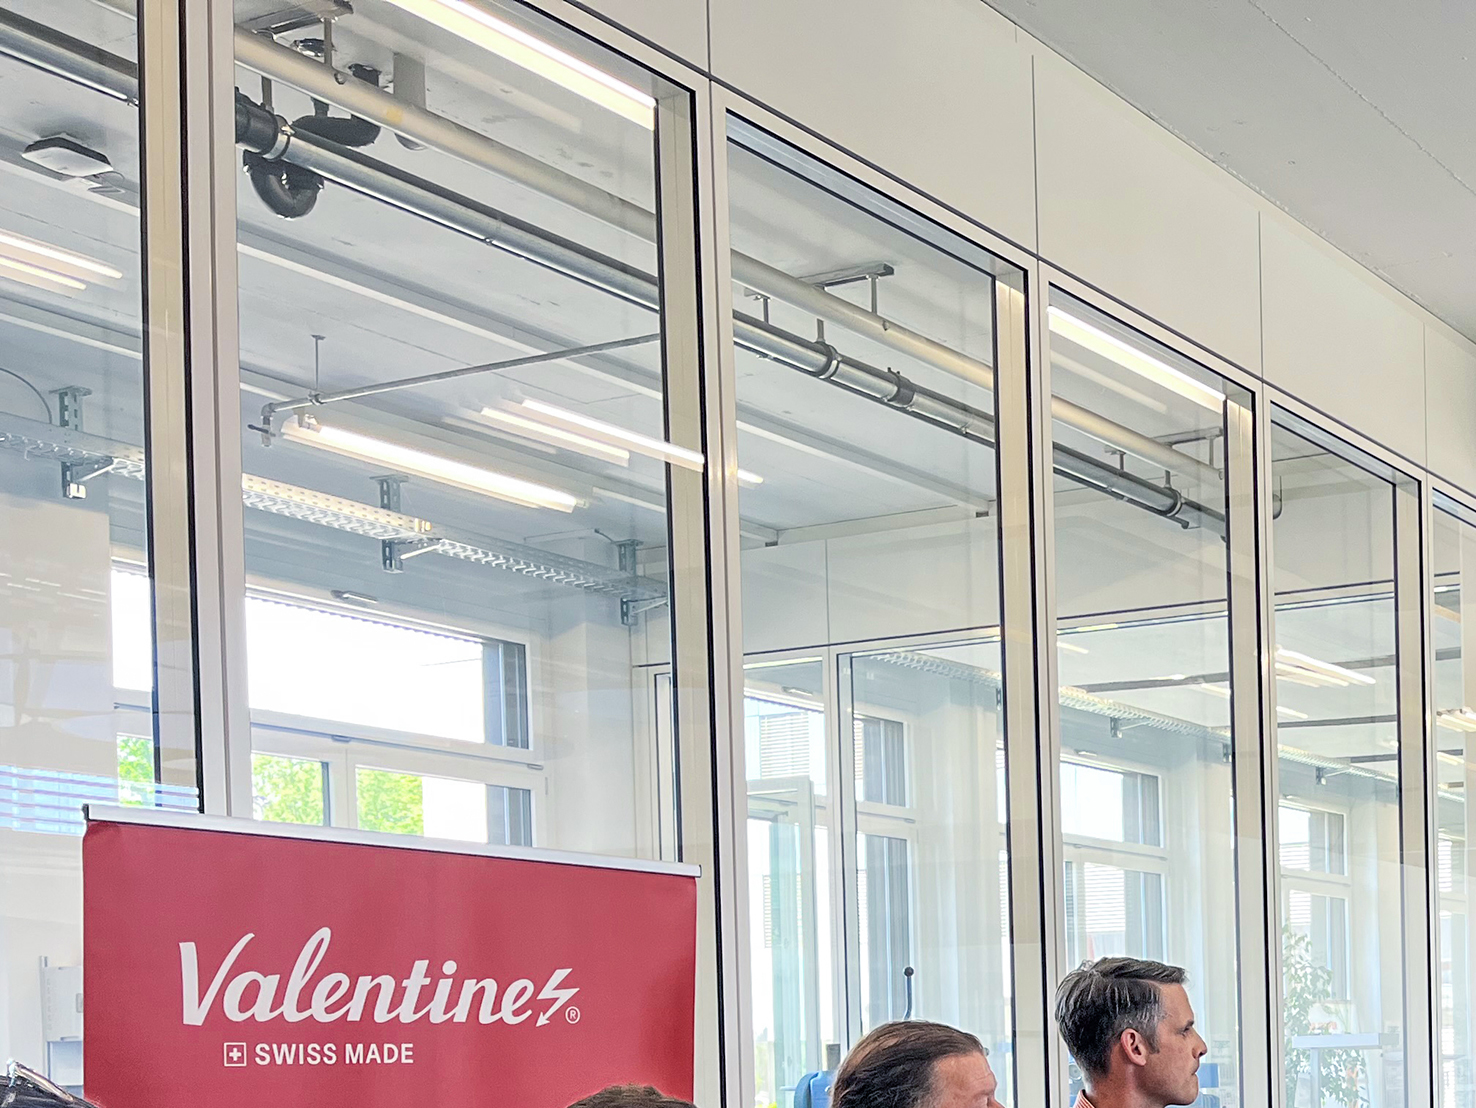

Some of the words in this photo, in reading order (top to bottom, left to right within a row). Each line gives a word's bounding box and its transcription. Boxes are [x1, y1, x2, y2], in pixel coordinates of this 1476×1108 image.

[179, 927, 534, 1025] Valentine
[255, 1042, 336, 1065] SWISS
[346, 1043, 413, 1063] MADE
